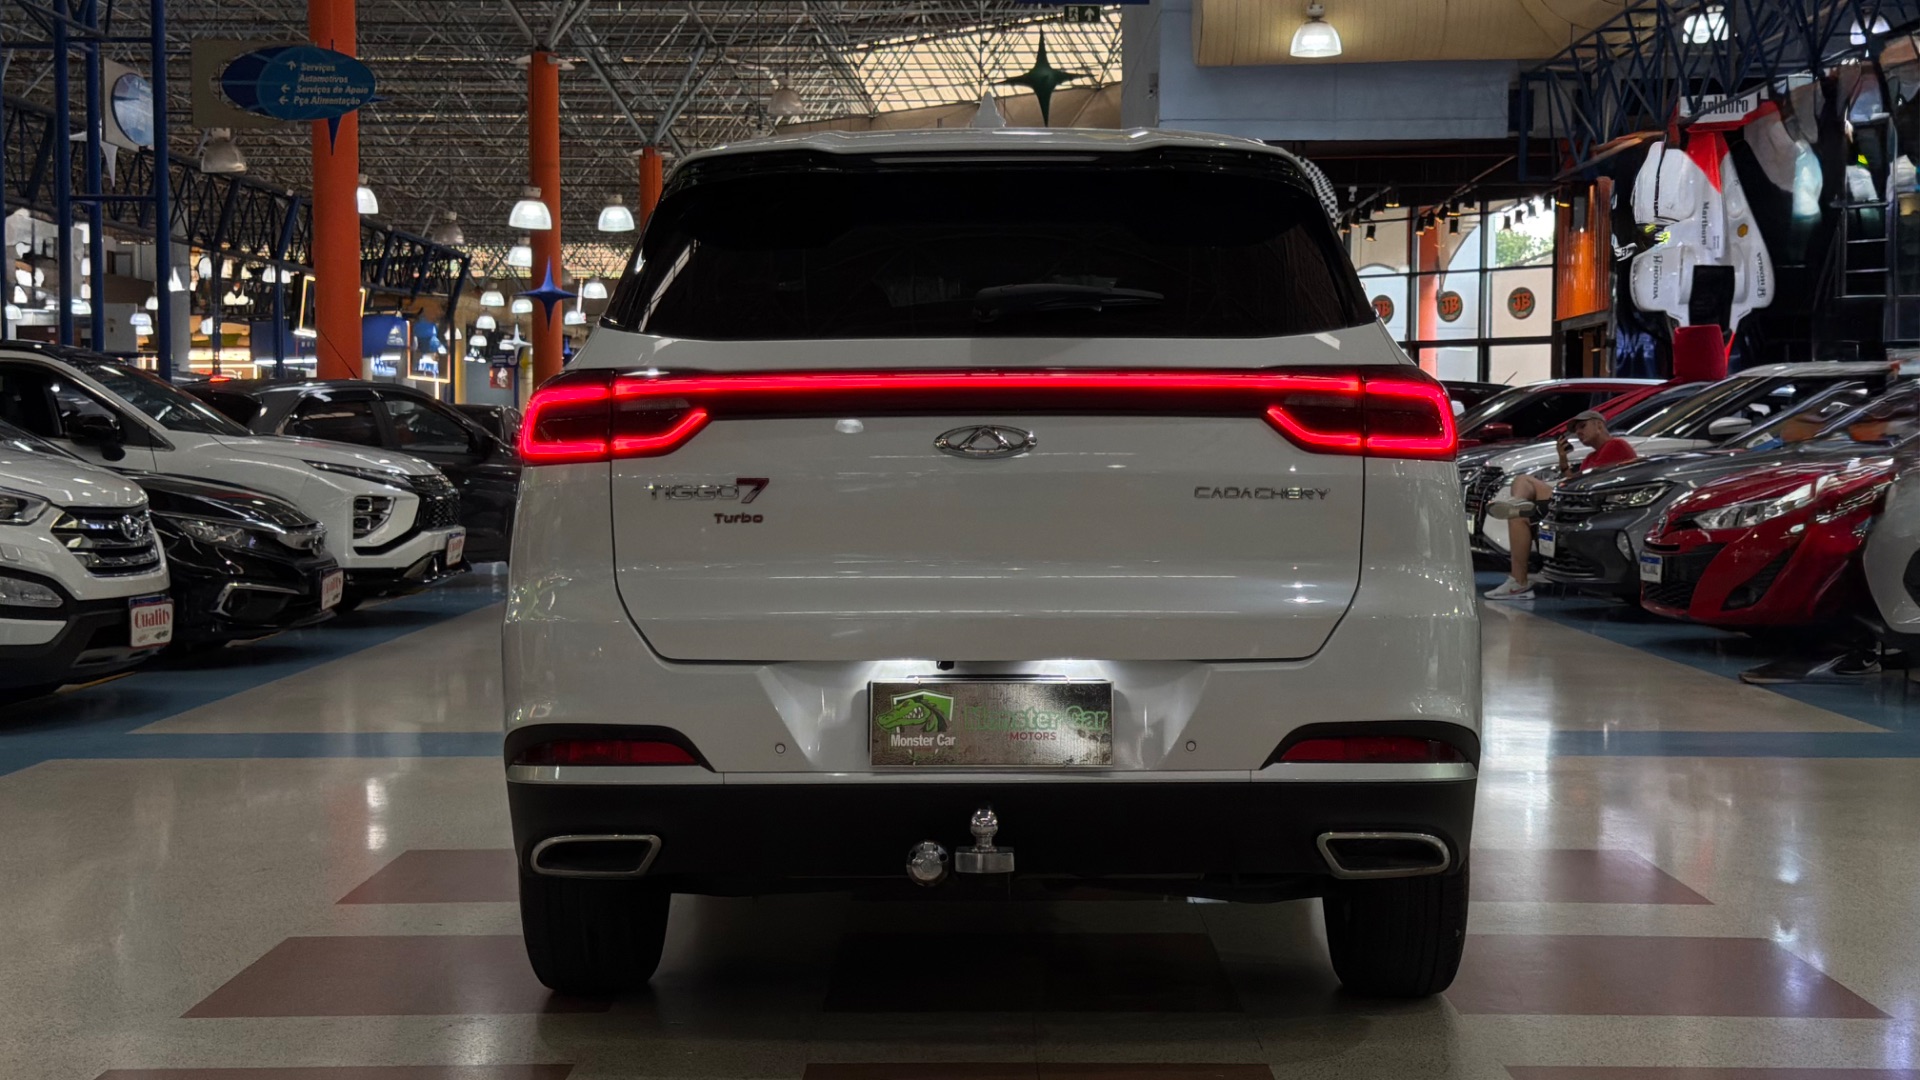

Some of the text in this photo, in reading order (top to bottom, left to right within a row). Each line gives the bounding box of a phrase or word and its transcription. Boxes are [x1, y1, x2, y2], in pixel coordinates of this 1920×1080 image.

[300, 62, 336, 73] Serviços
[298, 74, 348, 83] Automotivos
[296, 85, 369, 95] Serviços de Apoio
[293, 96, 361, 107] Pça Alimentação
[1702, 201, 1710, 246] Marlboro
[1441, 296, 1459, 314] JB
[1512, 292, 1532, 312] JB
[713, 512, 764, 524] Turbo
[963, 704, 1109, 731] Monster Car
[890, 733, 956, 747] Monster Car
[1009, 731, 1057, 741] MOTORS
